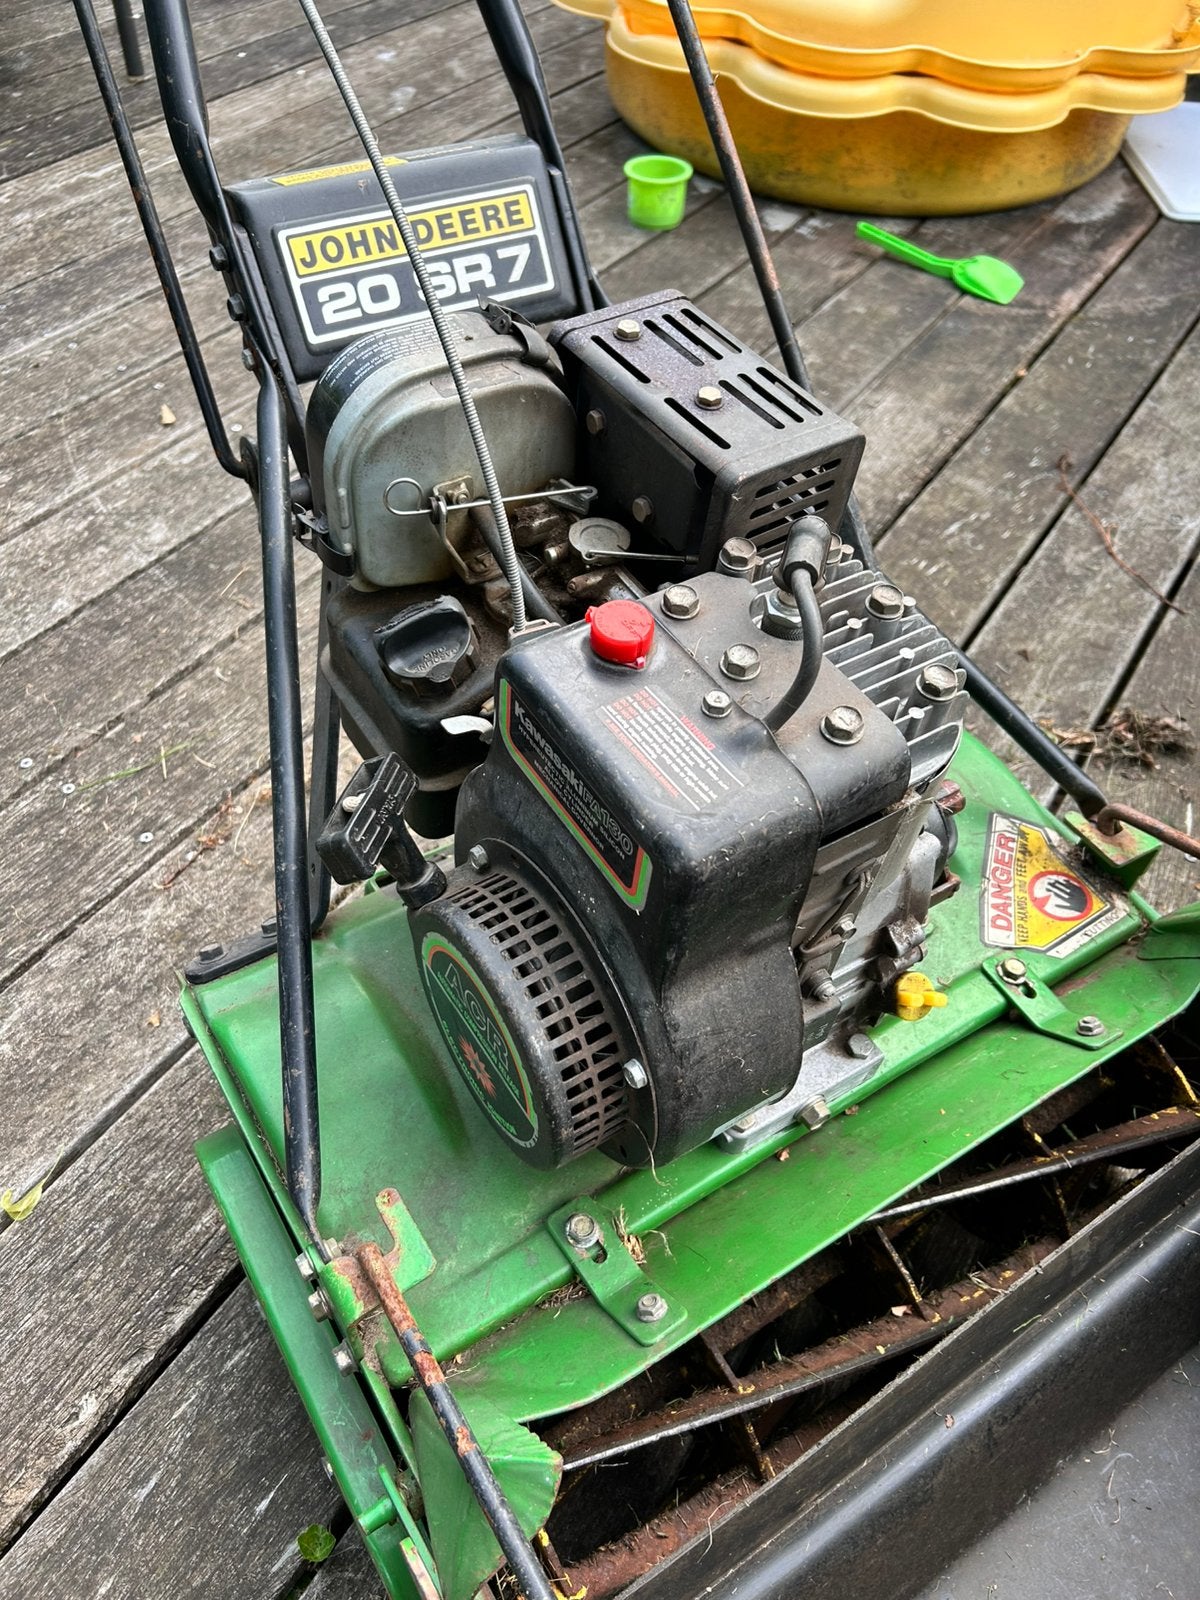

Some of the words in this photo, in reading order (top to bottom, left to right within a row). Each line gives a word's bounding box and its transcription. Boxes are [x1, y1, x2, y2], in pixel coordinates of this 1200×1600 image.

[300, 225, 398, 269] JOHN
[410, 199, 525, 248] DEERE
[316, 274, 400, 325] 20
[513, 700, 583, 796] Kawasaki
[678, 714, 716, 750] WARNING
[991, 833, 1017, 932] DANGER
[1016, 858, 1029, 879] FEET
[1018, 896, 1028, 923] HANDS
[1018, 924, 1029, 943] KEEP
[444, 962, 509, 1072] ACR
